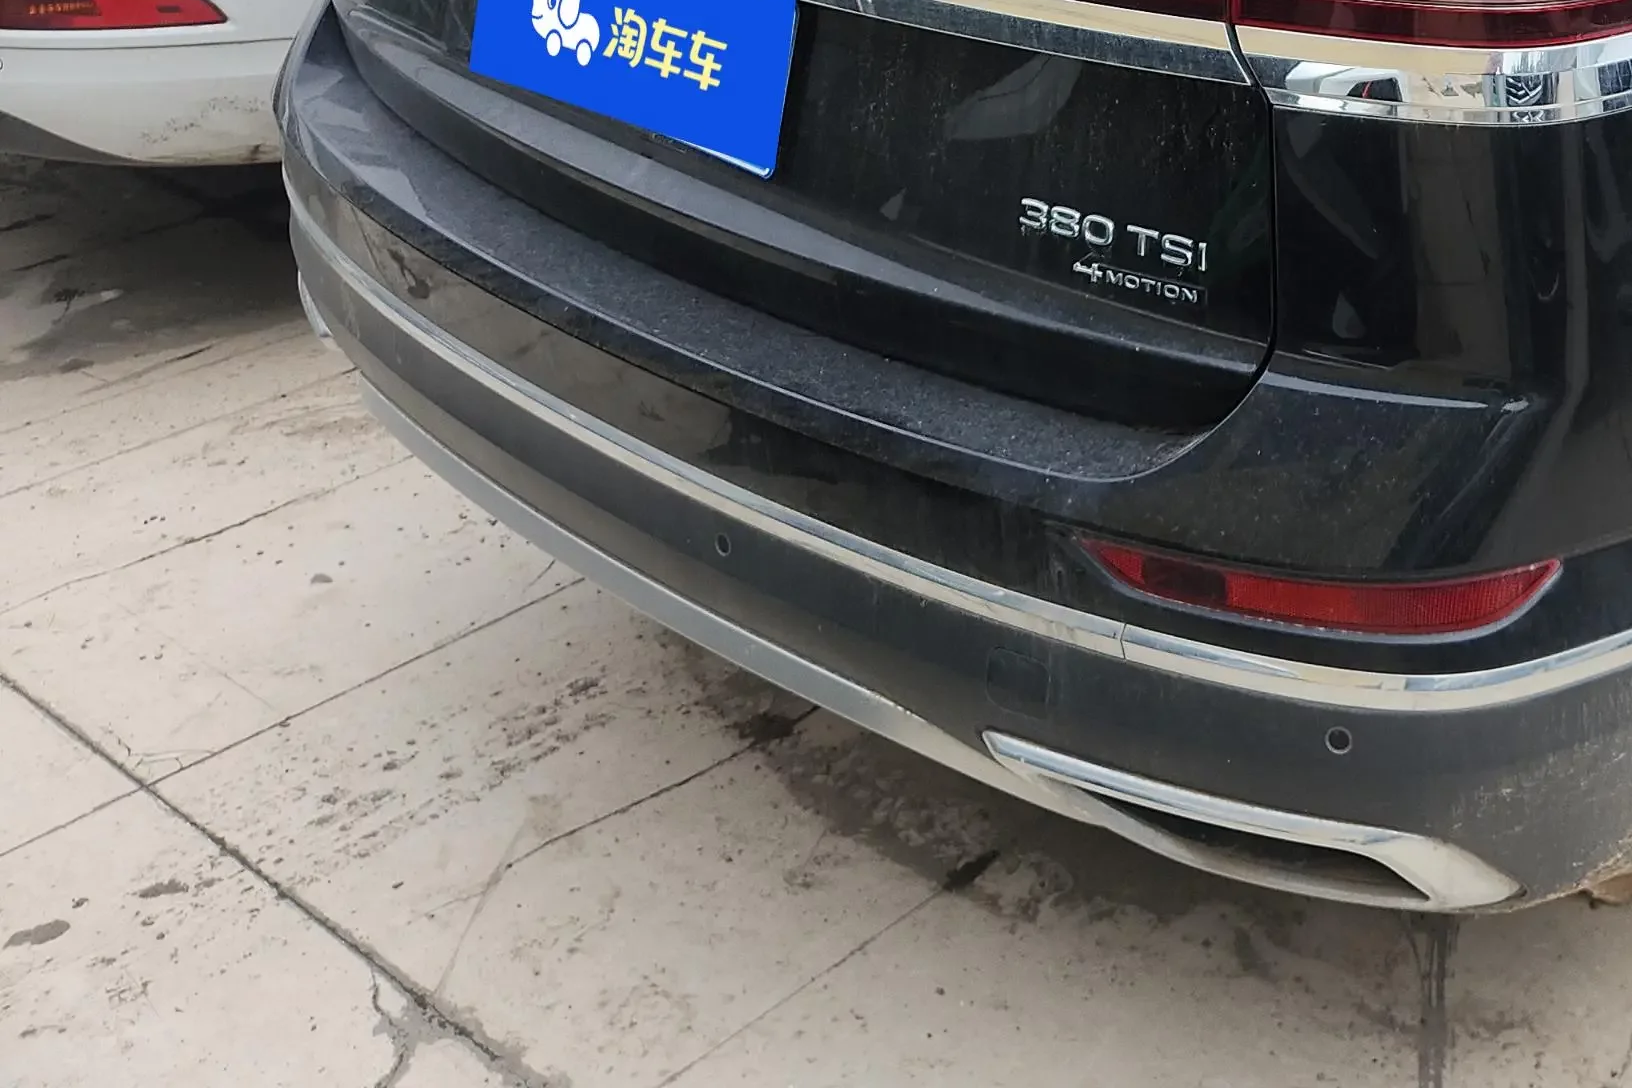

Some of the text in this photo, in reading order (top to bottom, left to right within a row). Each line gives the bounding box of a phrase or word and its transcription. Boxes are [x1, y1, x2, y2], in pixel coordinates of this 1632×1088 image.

[1019, 197, 1208, 272] 380 TSI
[1072, 252, 1199, 305] 4MOTION
